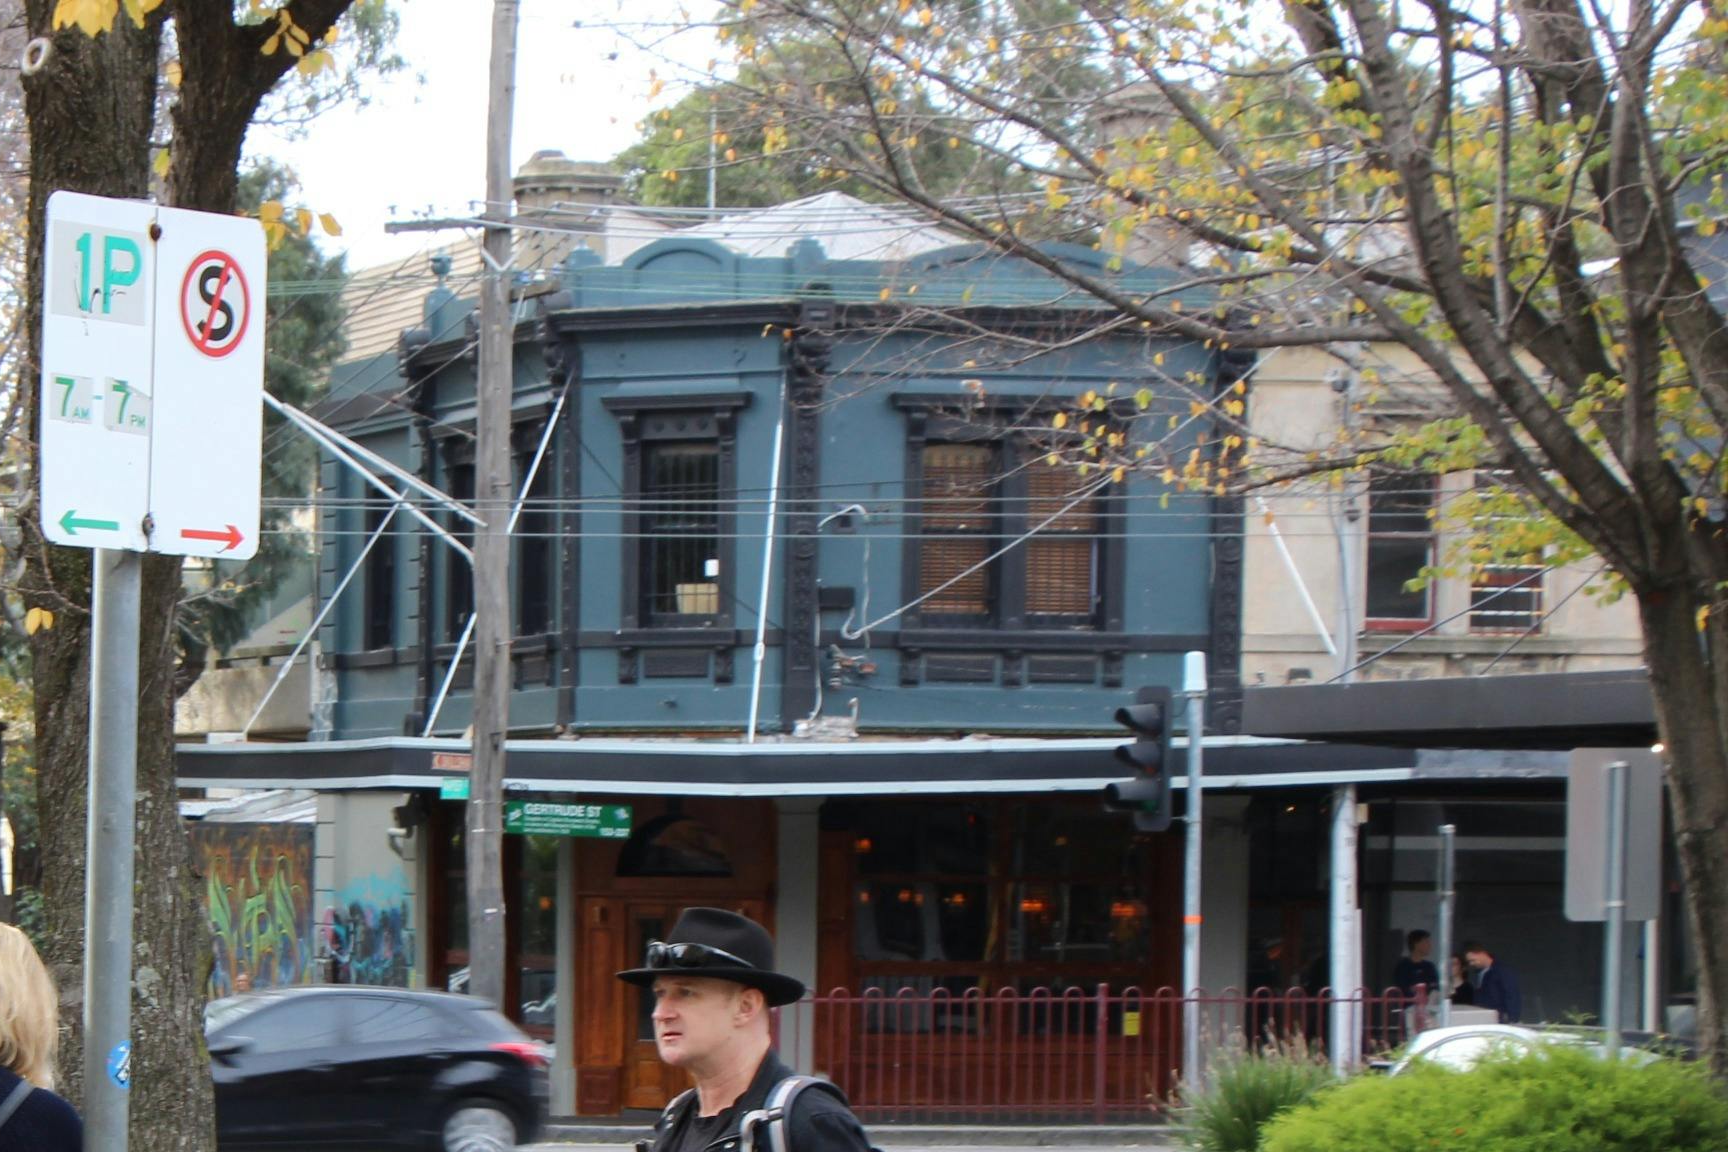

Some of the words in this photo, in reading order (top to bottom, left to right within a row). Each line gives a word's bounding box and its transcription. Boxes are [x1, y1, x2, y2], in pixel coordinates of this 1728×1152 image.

[75, 232, 142, 314] 1P
[523, 803, 585, 817] GERTRUDE
[586, 805, 603, 818] ST
